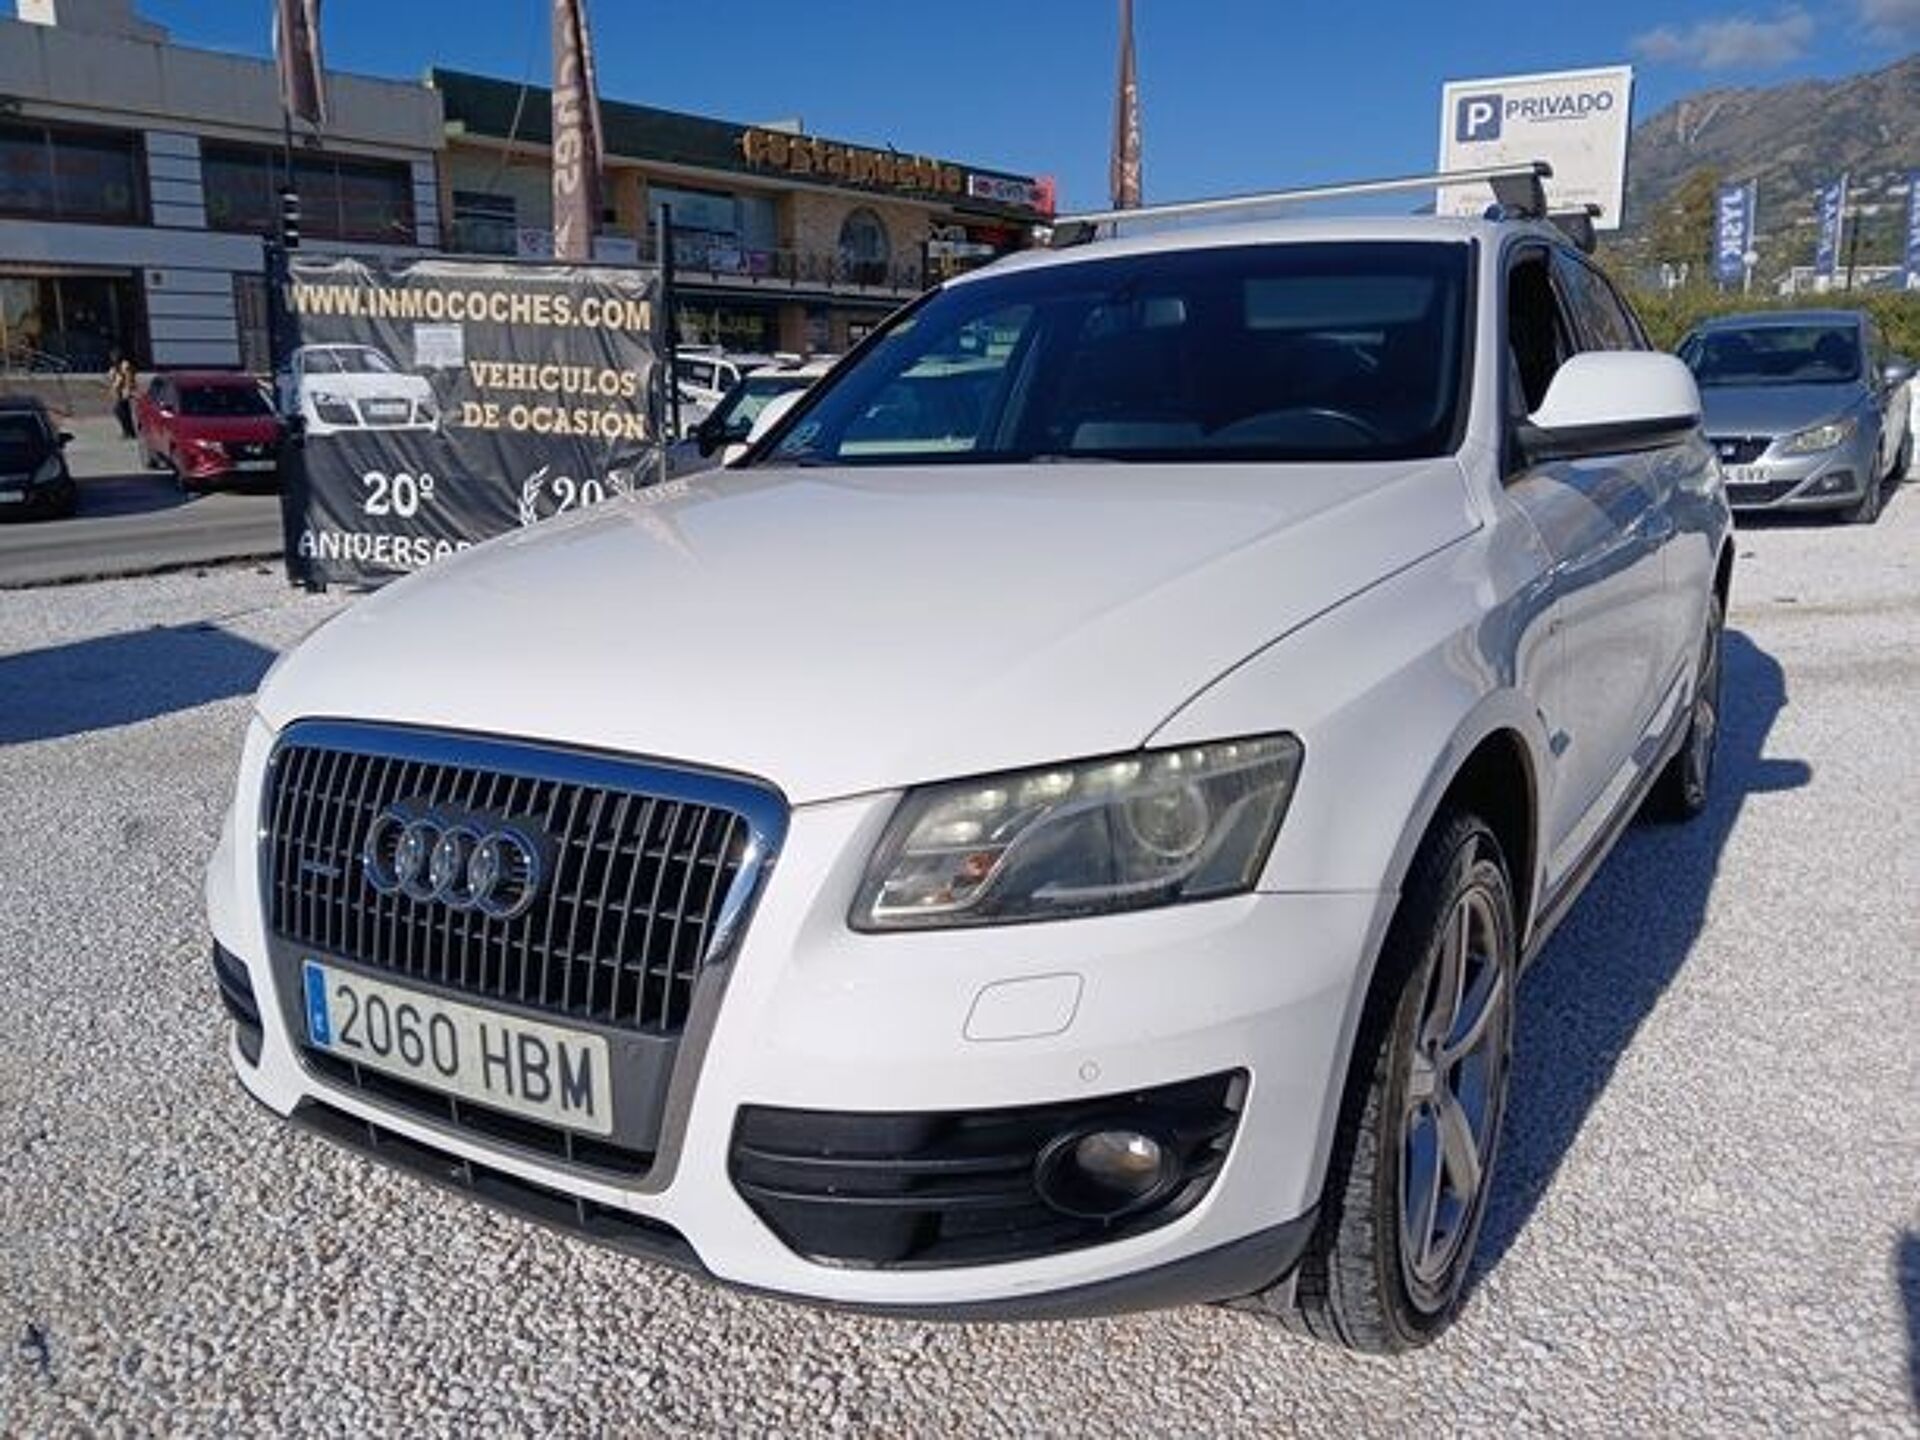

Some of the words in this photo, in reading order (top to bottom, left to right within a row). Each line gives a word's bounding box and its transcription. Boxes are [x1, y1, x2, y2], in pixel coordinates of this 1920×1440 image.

[1467, 102, 1493, 136] P
[1505, 91, 1614, 119] PRIVADO
[283, 283, 651, 331] WWW.INMOCOCHES.COM
[469, 360, 638, 395] VEHICULOS
[462, 401, 501, 429] DE
[335, 985, 460, 1078] 2060
[478, 1023, 595, 1117] HBM
